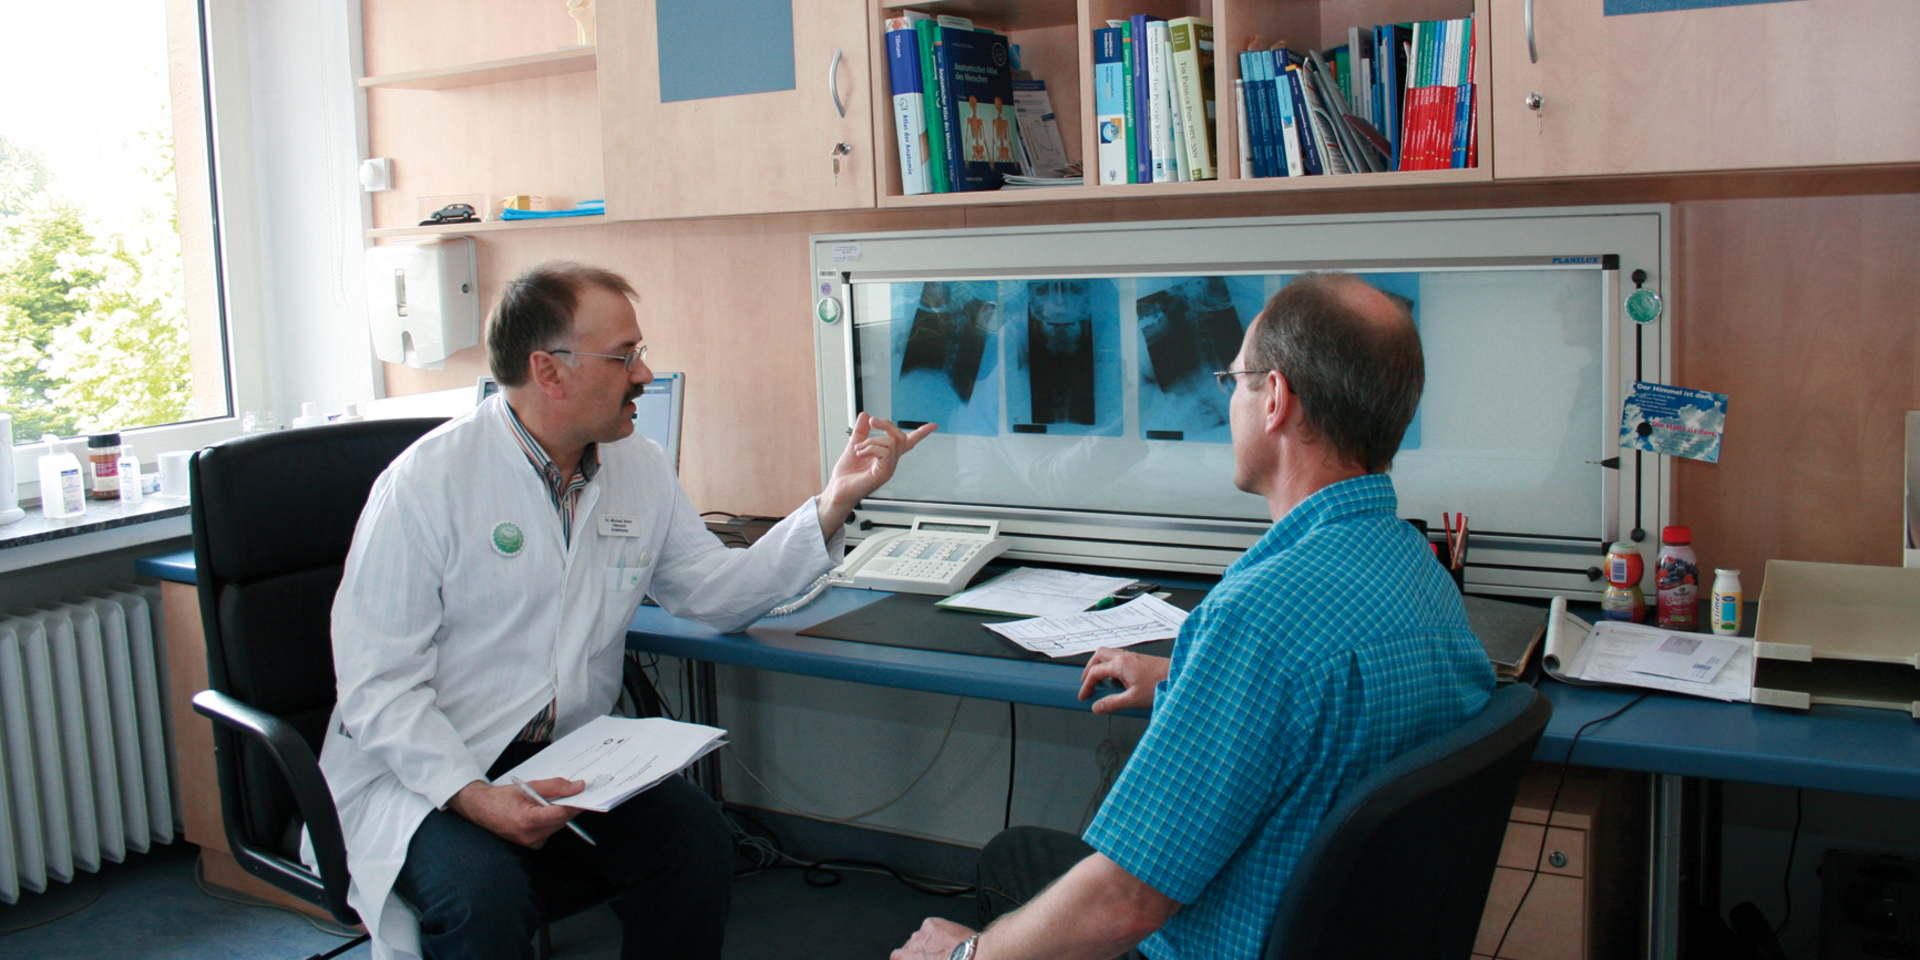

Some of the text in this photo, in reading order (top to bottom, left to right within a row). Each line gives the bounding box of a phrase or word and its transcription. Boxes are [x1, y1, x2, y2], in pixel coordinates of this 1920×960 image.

[954, 62, 998, 75] Anatomischer Atlas
[1180, 61, 1188, 76] THE
[955, 72, 988, 83] des Menschen
[1125, 75, 1133, 127] Elektromyographie
[1185, 97, 1191, 105] OF
[938, 68, 948, 105] Anatomischer
[945, 132, 953, 160] Menschen
[1185, 106, 1193, 122] PAIN
[905, 144, 913, 176] Anatomie
[1653, 385, 1682, 396] Himmel
